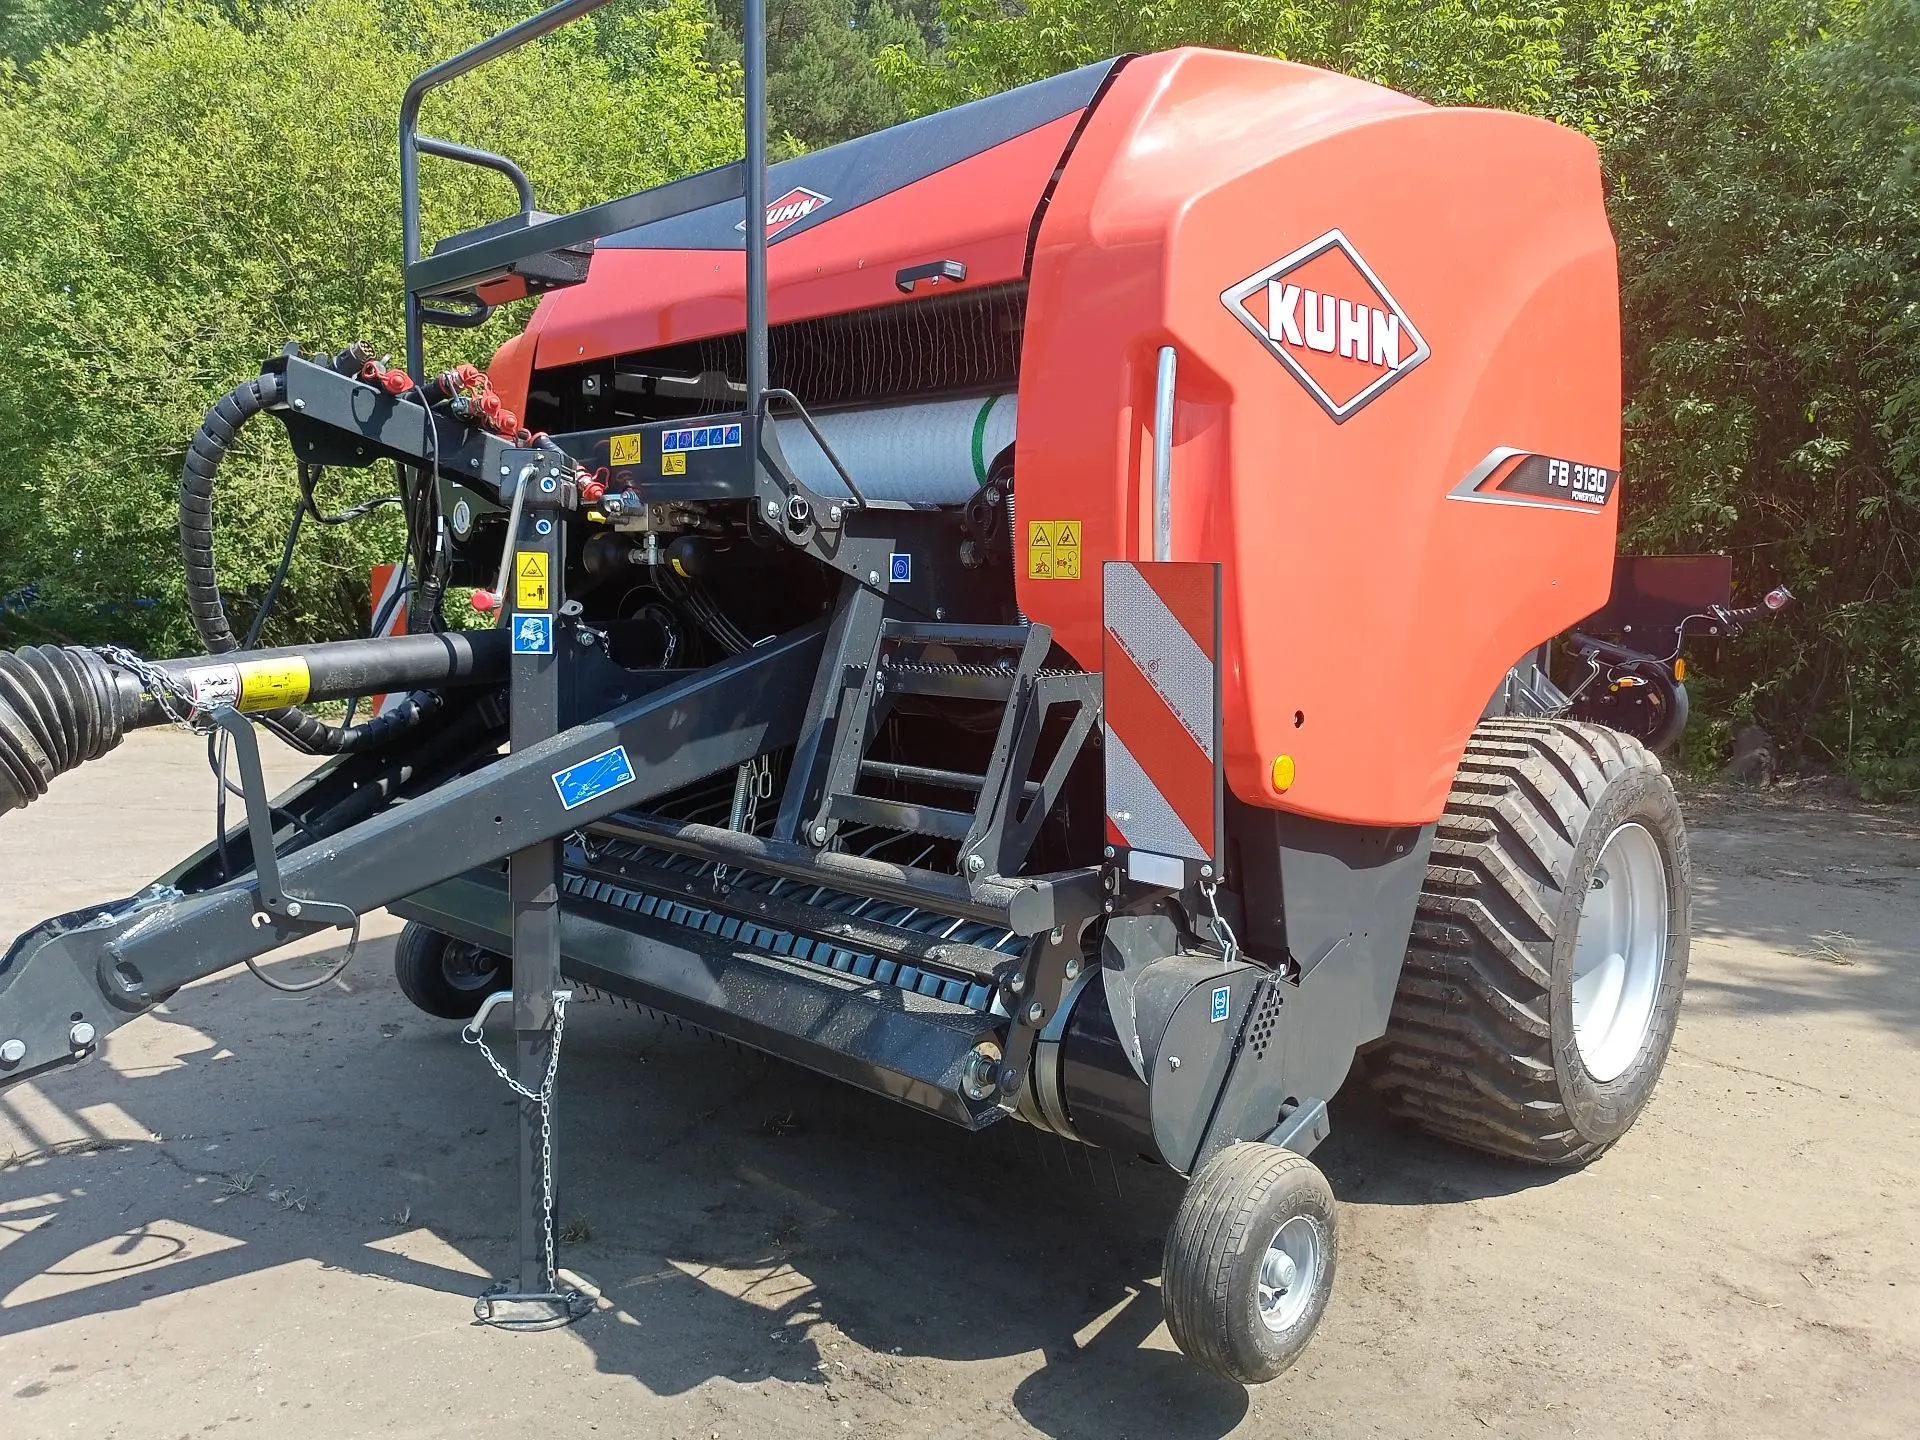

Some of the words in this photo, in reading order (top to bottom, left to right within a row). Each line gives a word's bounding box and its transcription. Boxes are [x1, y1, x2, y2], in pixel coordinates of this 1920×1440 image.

[766, 198, 818, 226] UHN
[1268, 279, 1399, 370] KUHN
[1548, 459, 1570, 487] FB
[1573, 464, 1607, 493] 3130
[1571, 490, 1605, 505] POWERTRACK
